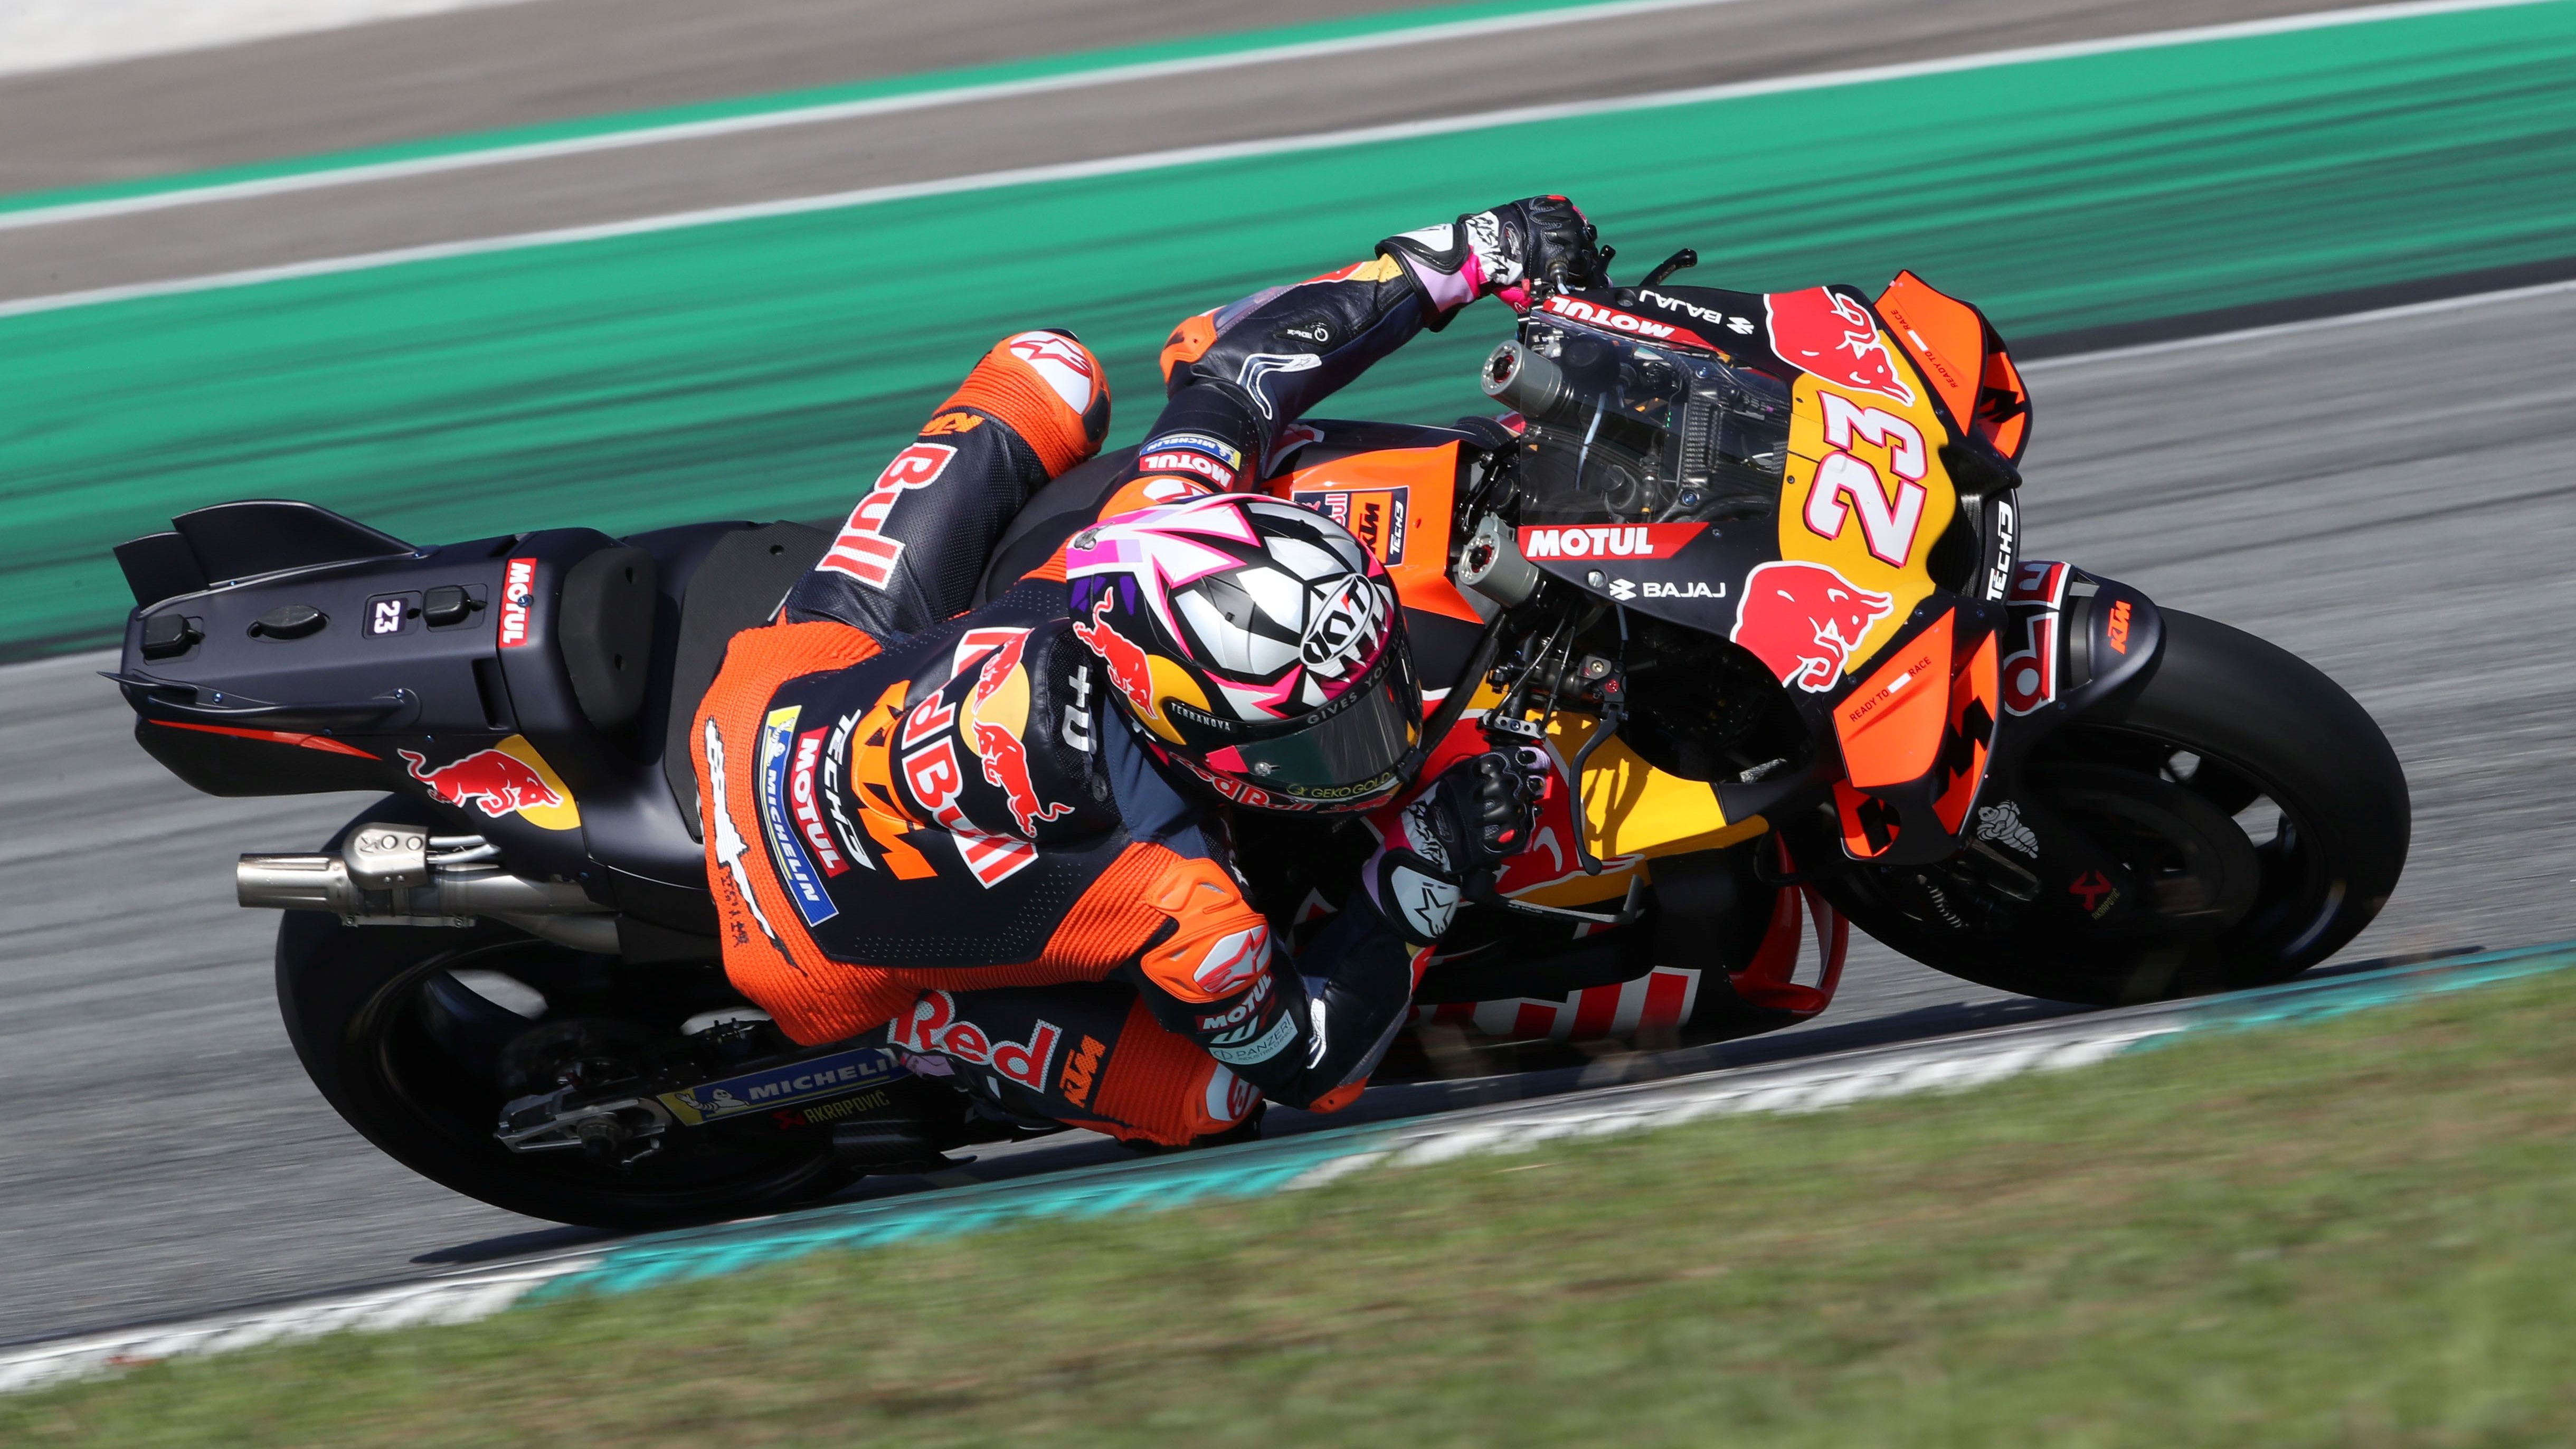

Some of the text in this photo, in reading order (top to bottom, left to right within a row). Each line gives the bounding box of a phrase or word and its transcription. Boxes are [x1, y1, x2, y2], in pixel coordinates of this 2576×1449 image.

[1550, 297, 1675, 337] MOTUL
[1639, 290, 1722, 324] BAJAJ
[1891, 309, 1958, 388] READY TO RACE
[1144, 454, 1232, 488] MOTUL
[1147, 437, 1216, 451] MICHELIN
[1804, 390, 1927, 567] 23
[815, 442, 958, 590] Bull
[1359, 503, 1380, 555] KTM
[1390, 500, 1404, 554] TECH3
[1527, 527, 1654, 557] MOTUL
[1986, 500, 2013, 601] TECH3
[374, 600, 401, 633] 23
[502, 562, 532, 643] MOTUL
[1643, 582, 1726, 598] BAJAJ
[2108, 600, 2132, 655] KTM
[1171, 703, 1231, 731] TERRANOVA
[1307, 658, 1389, 724] GIVES YOU
[1849, 657, 1932, 722] READY TO RACE
[794, 738, 840, 869] MOTUL
[824, 709, 876, 870] TECH3
[1311, 771, 1391, 798] GEKO GOLD
[766, 769, 820, 902] MICHELIN
[1202, 974, 1272, 1029] MOTUL
[887, 989, 1063, 1094] Red
[1059, 1034, 1106, 1109] KTM
